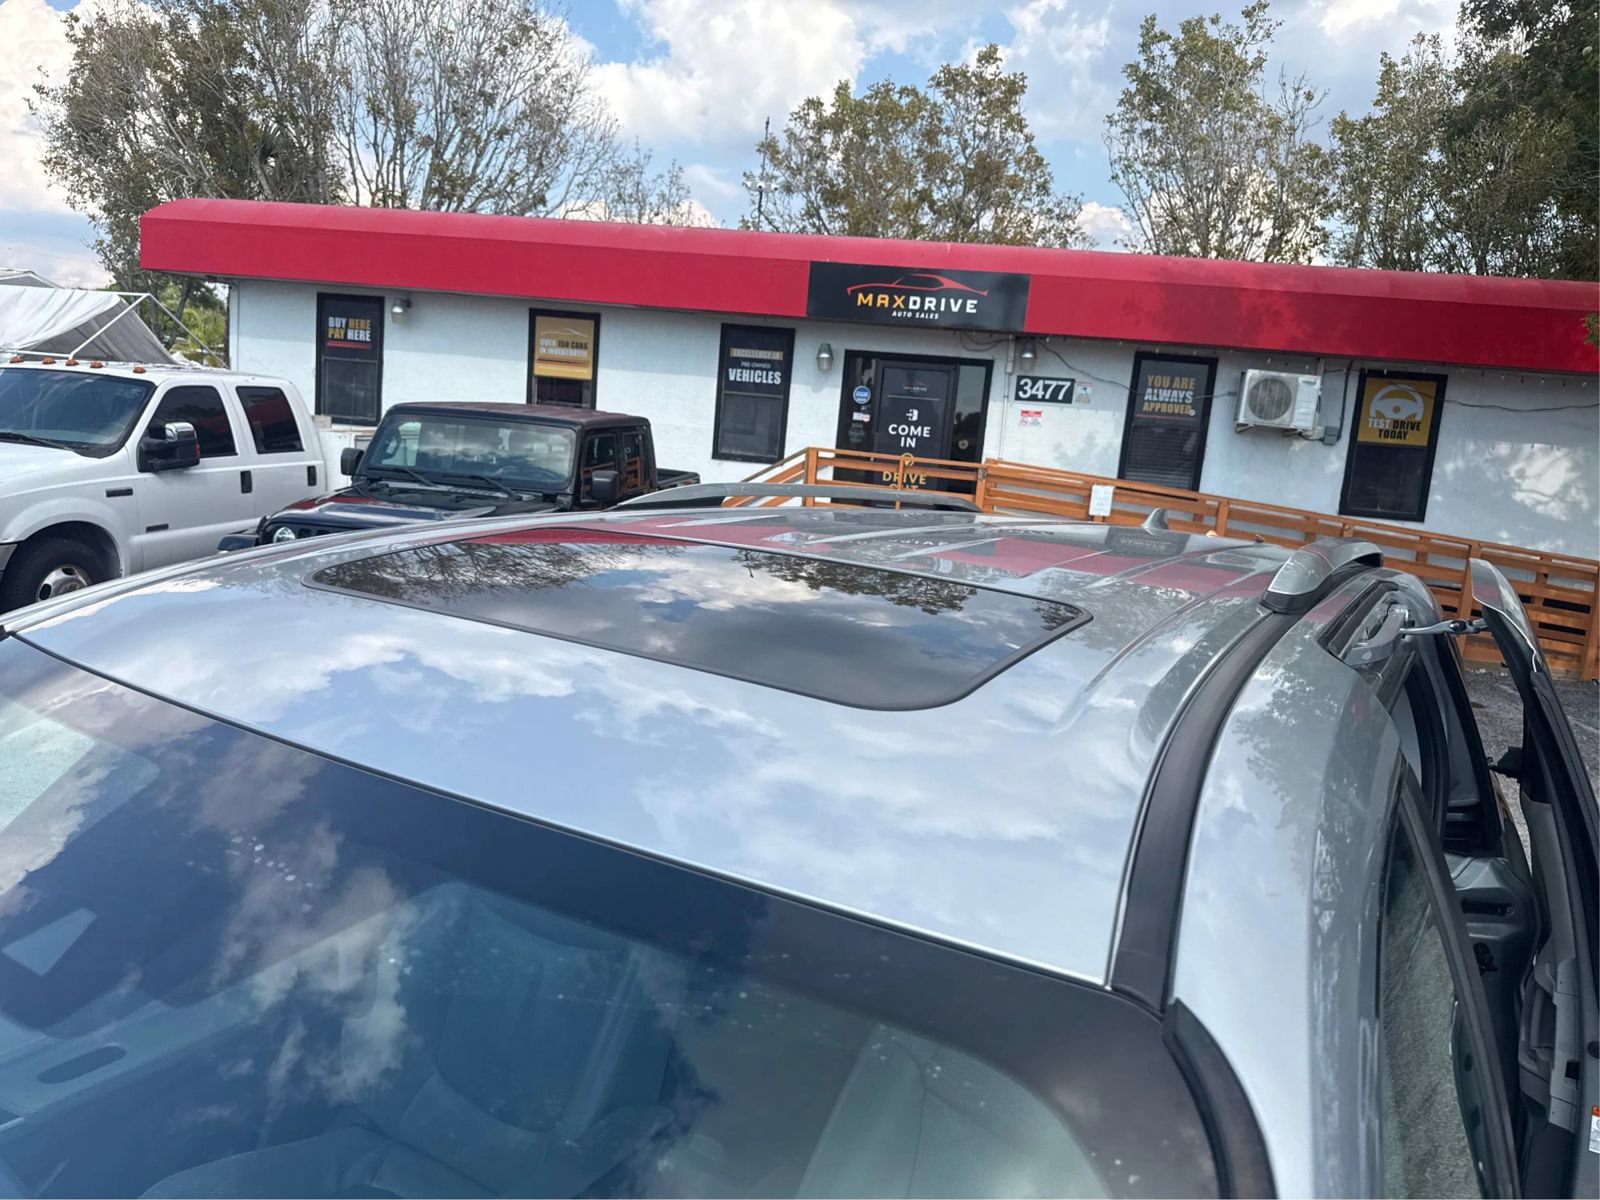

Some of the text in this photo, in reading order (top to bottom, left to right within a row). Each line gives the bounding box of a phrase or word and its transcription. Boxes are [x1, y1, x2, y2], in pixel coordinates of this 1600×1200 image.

[857, 292, 978, 314] MAXDRIVE
[892, 310, 939, 320] AUTO SALES
[328, 316, 371, 330] BUY HERE
[327, 328, 371, 342] PAY HERE
[728, 367, 782, 385] VEHICLES
[1147, 374, 1196, 390] YOU ARE
[1018, 378, 1071, 401] 3477
[1143, 387, 1193, 404] ALWAYS
[1143, 401, 1192, 415] APPROVED
[888, 424, 931, 437] COME
[1368, 418, 1422, 432] TEST DRIVE
[1378, 429, 1409, 440] TODAY
[900, 436, 917, 448] IN
